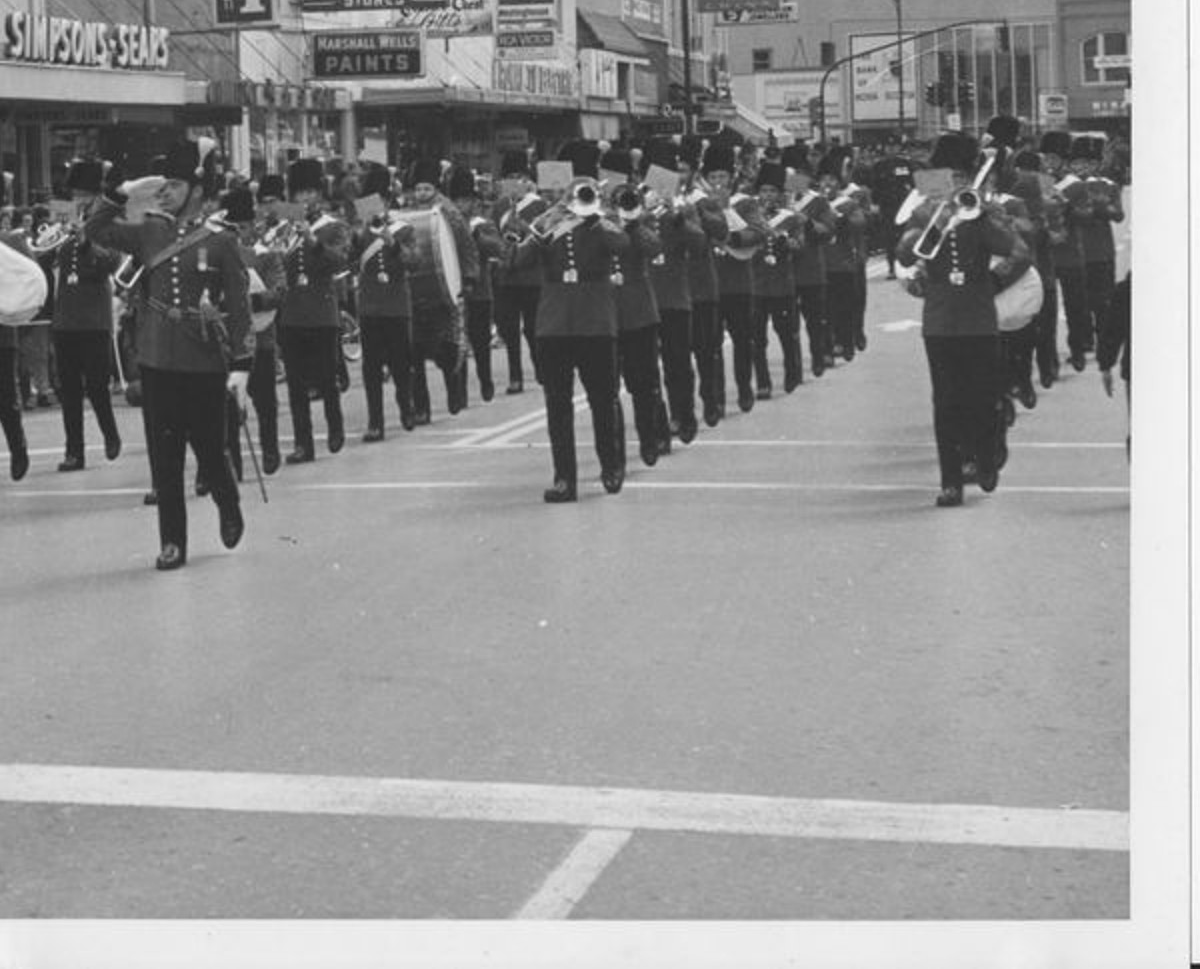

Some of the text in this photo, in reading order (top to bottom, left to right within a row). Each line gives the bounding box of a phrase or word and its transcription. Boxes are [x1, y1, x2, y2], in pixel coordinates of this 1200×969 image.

[317, 34, 417, 50] MARSHALL WELLS
[325, 54, 409, 73] PAINTS
